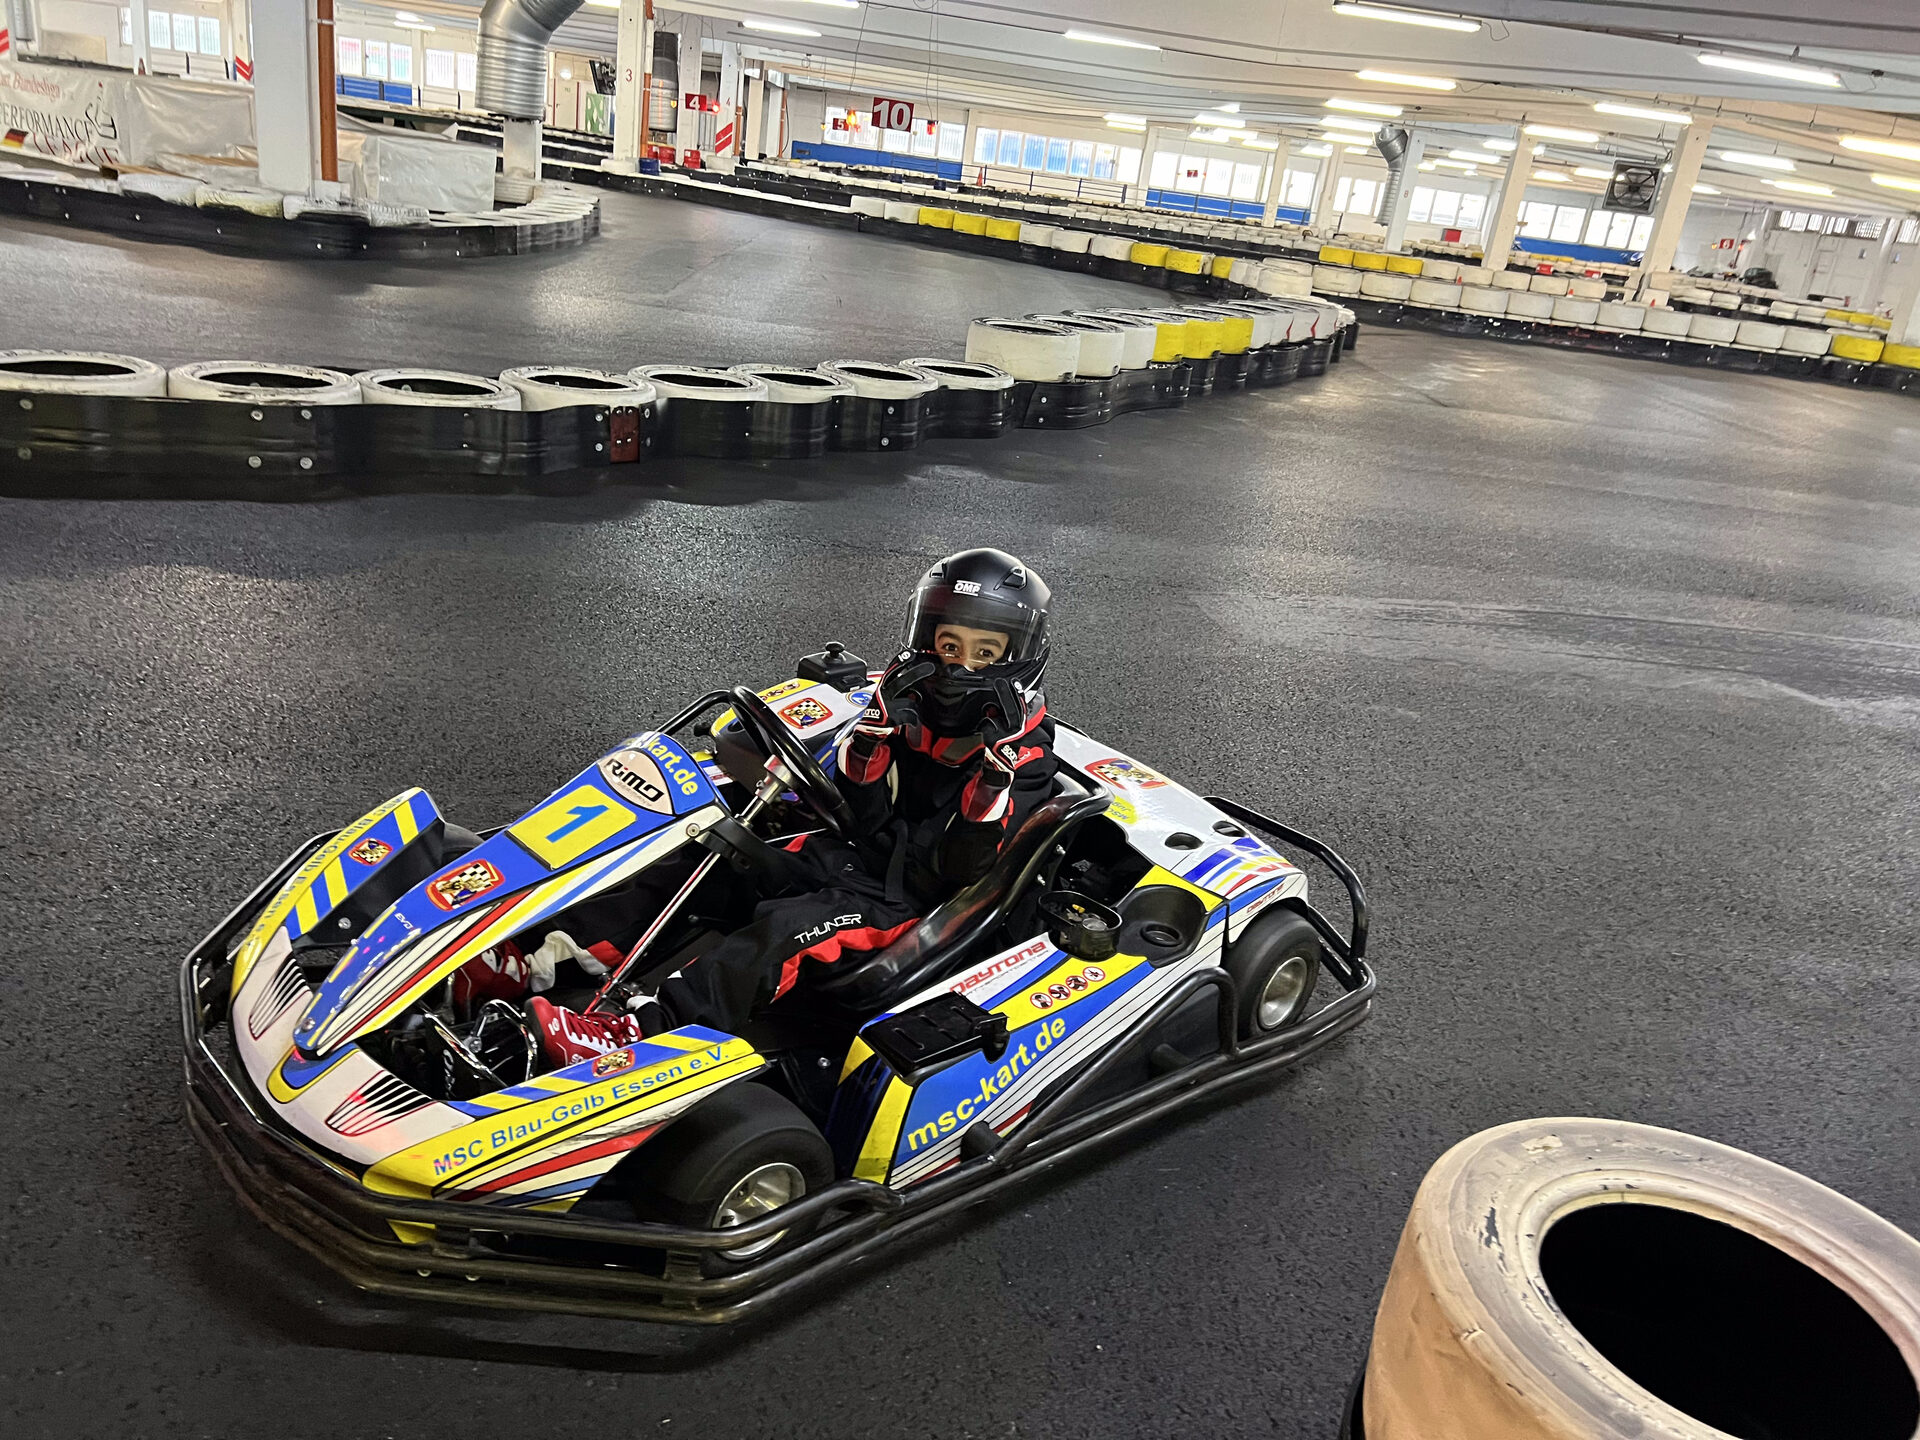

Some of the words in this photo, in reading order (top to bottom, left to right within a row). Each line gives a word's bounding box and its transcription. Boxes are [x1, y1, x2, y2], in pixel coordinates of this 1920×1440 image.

[626, 68, 633, 82] 3
[689, 95, 701, 110] 4
[873, 100, 911, 131] 10
[837, 119, 845, 130] 5
[954, 581, 981, 594] OMP
[862, 708, 881, 718] arco
[647, 736, 699, 796] kart.de
[545, 804, 609, 843] 1
[794, 913, 862, 944] THUNDER
[907, 1017, 1066, 1151] msc-kart.de
[433, 1140, 483, 1176] MSC
[491, 1093, 604, 1148] Blau-Gelb
[612, 1063, 683, 1100] Essen
[689, 1045, 729, 1070] e.V.
